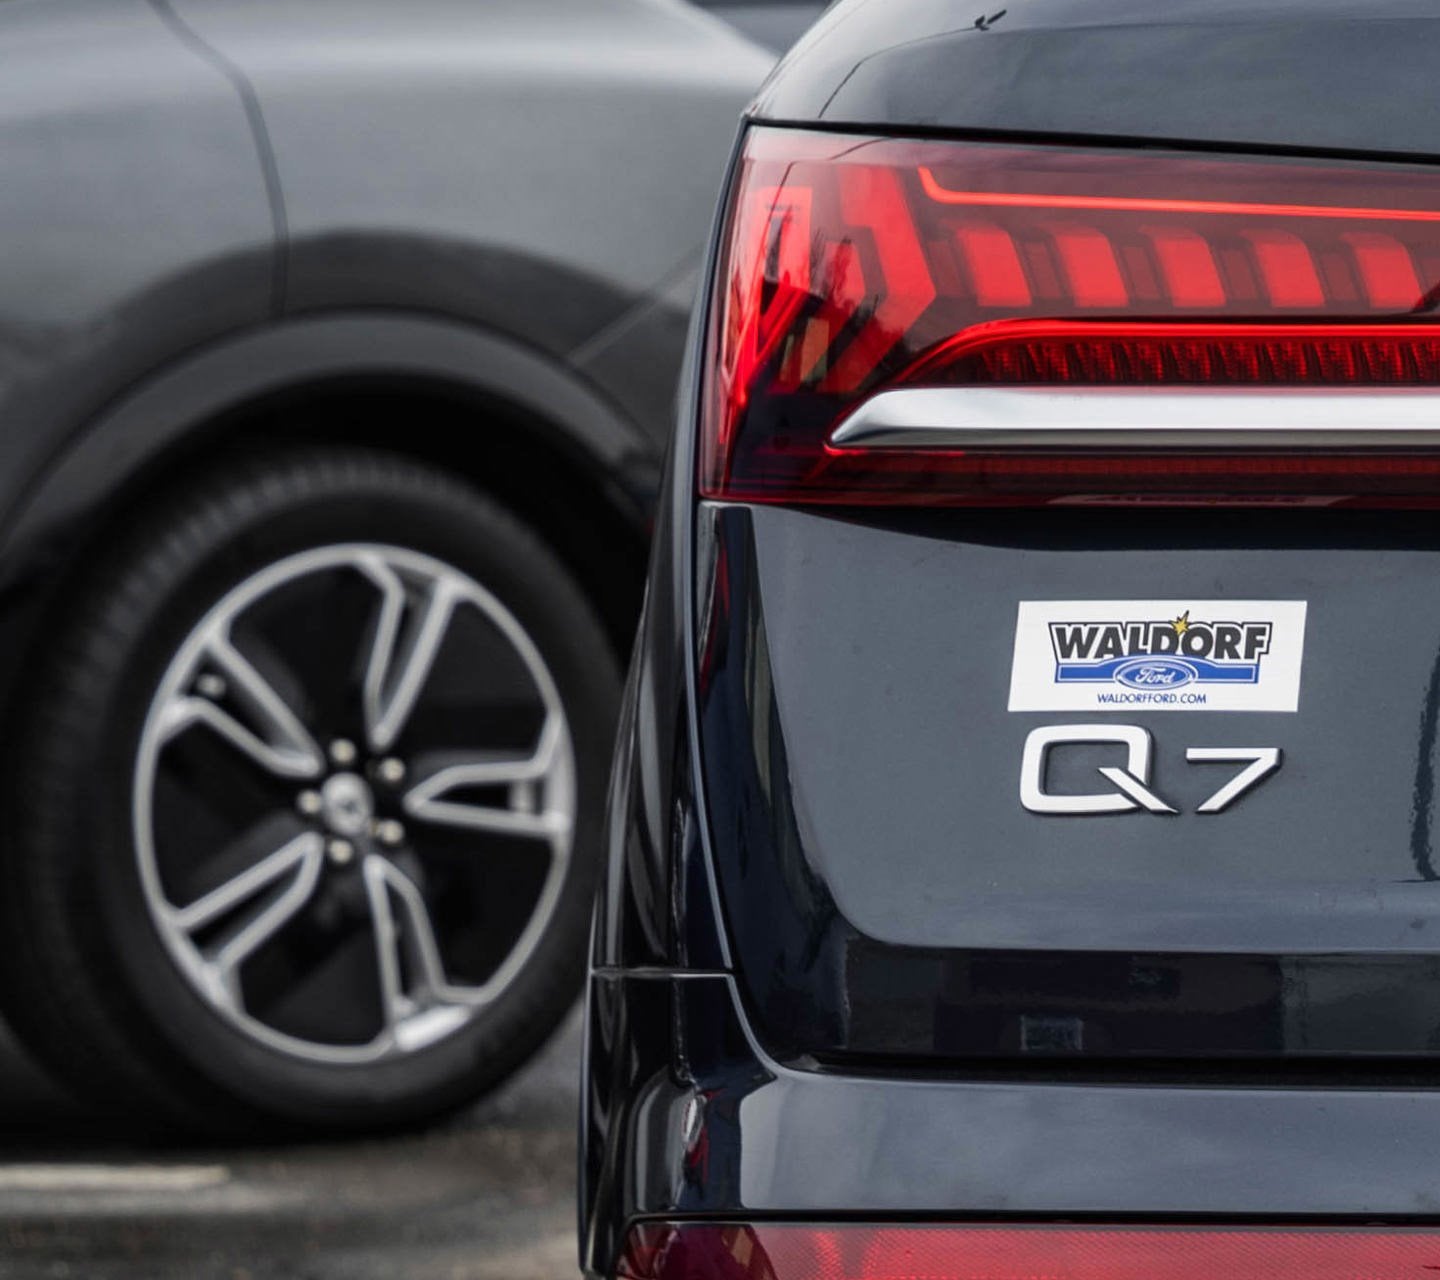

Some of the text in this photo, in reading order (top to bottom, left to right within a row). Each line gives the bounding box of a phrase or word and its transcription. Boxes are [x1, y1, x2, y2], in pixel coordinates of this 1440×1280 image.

[1051, 623, 1271, 660] WALDORF
[1134, 667, 1176, 683] Ford
[1096, 692, 1208, 705] WALDORFFORD.COM
[1019, 723, 1283, 814] Q7
